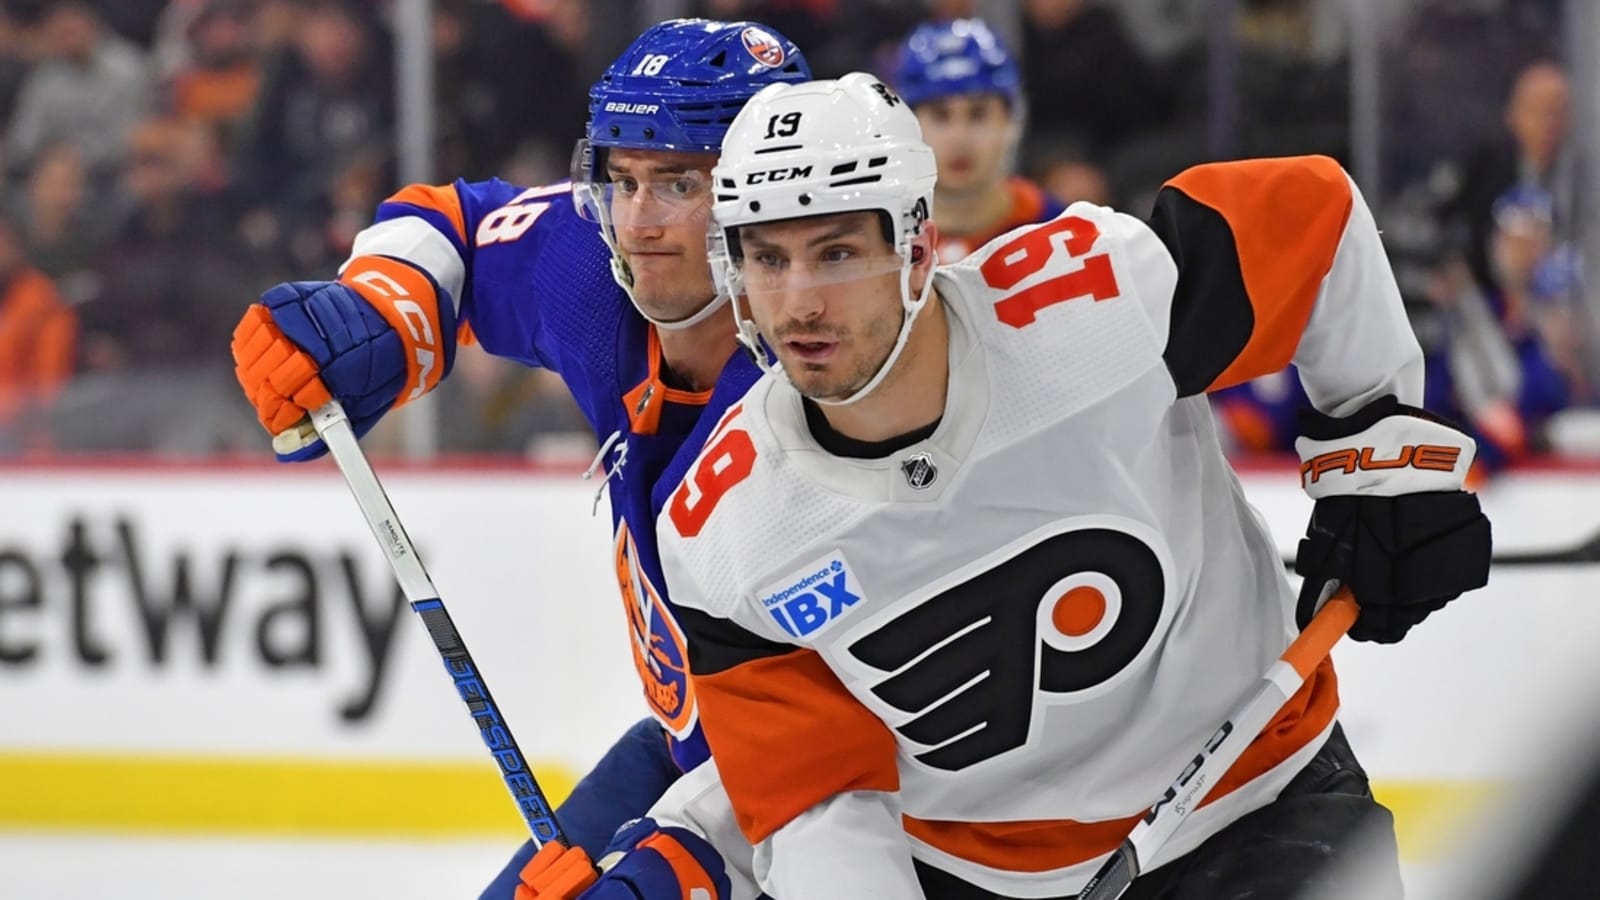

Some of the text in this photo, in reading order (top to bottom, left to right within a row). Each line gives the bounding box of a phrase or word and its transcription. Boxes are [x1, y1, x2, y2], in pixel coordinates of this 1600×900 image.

[632, 55, 669, 76] 18
[605, 102, 660, 115] BAUER
[764, 112, 803, 140] 19
[746, 166, 813, 186] CCM
[979, 215, 1121, 329] 19
[668, 403, 758, 538] 9
[762, 566, 831, 608] Independence
[769, 571, 861, 638] IBX
[443, 656, 560, 842] JETSPEED
